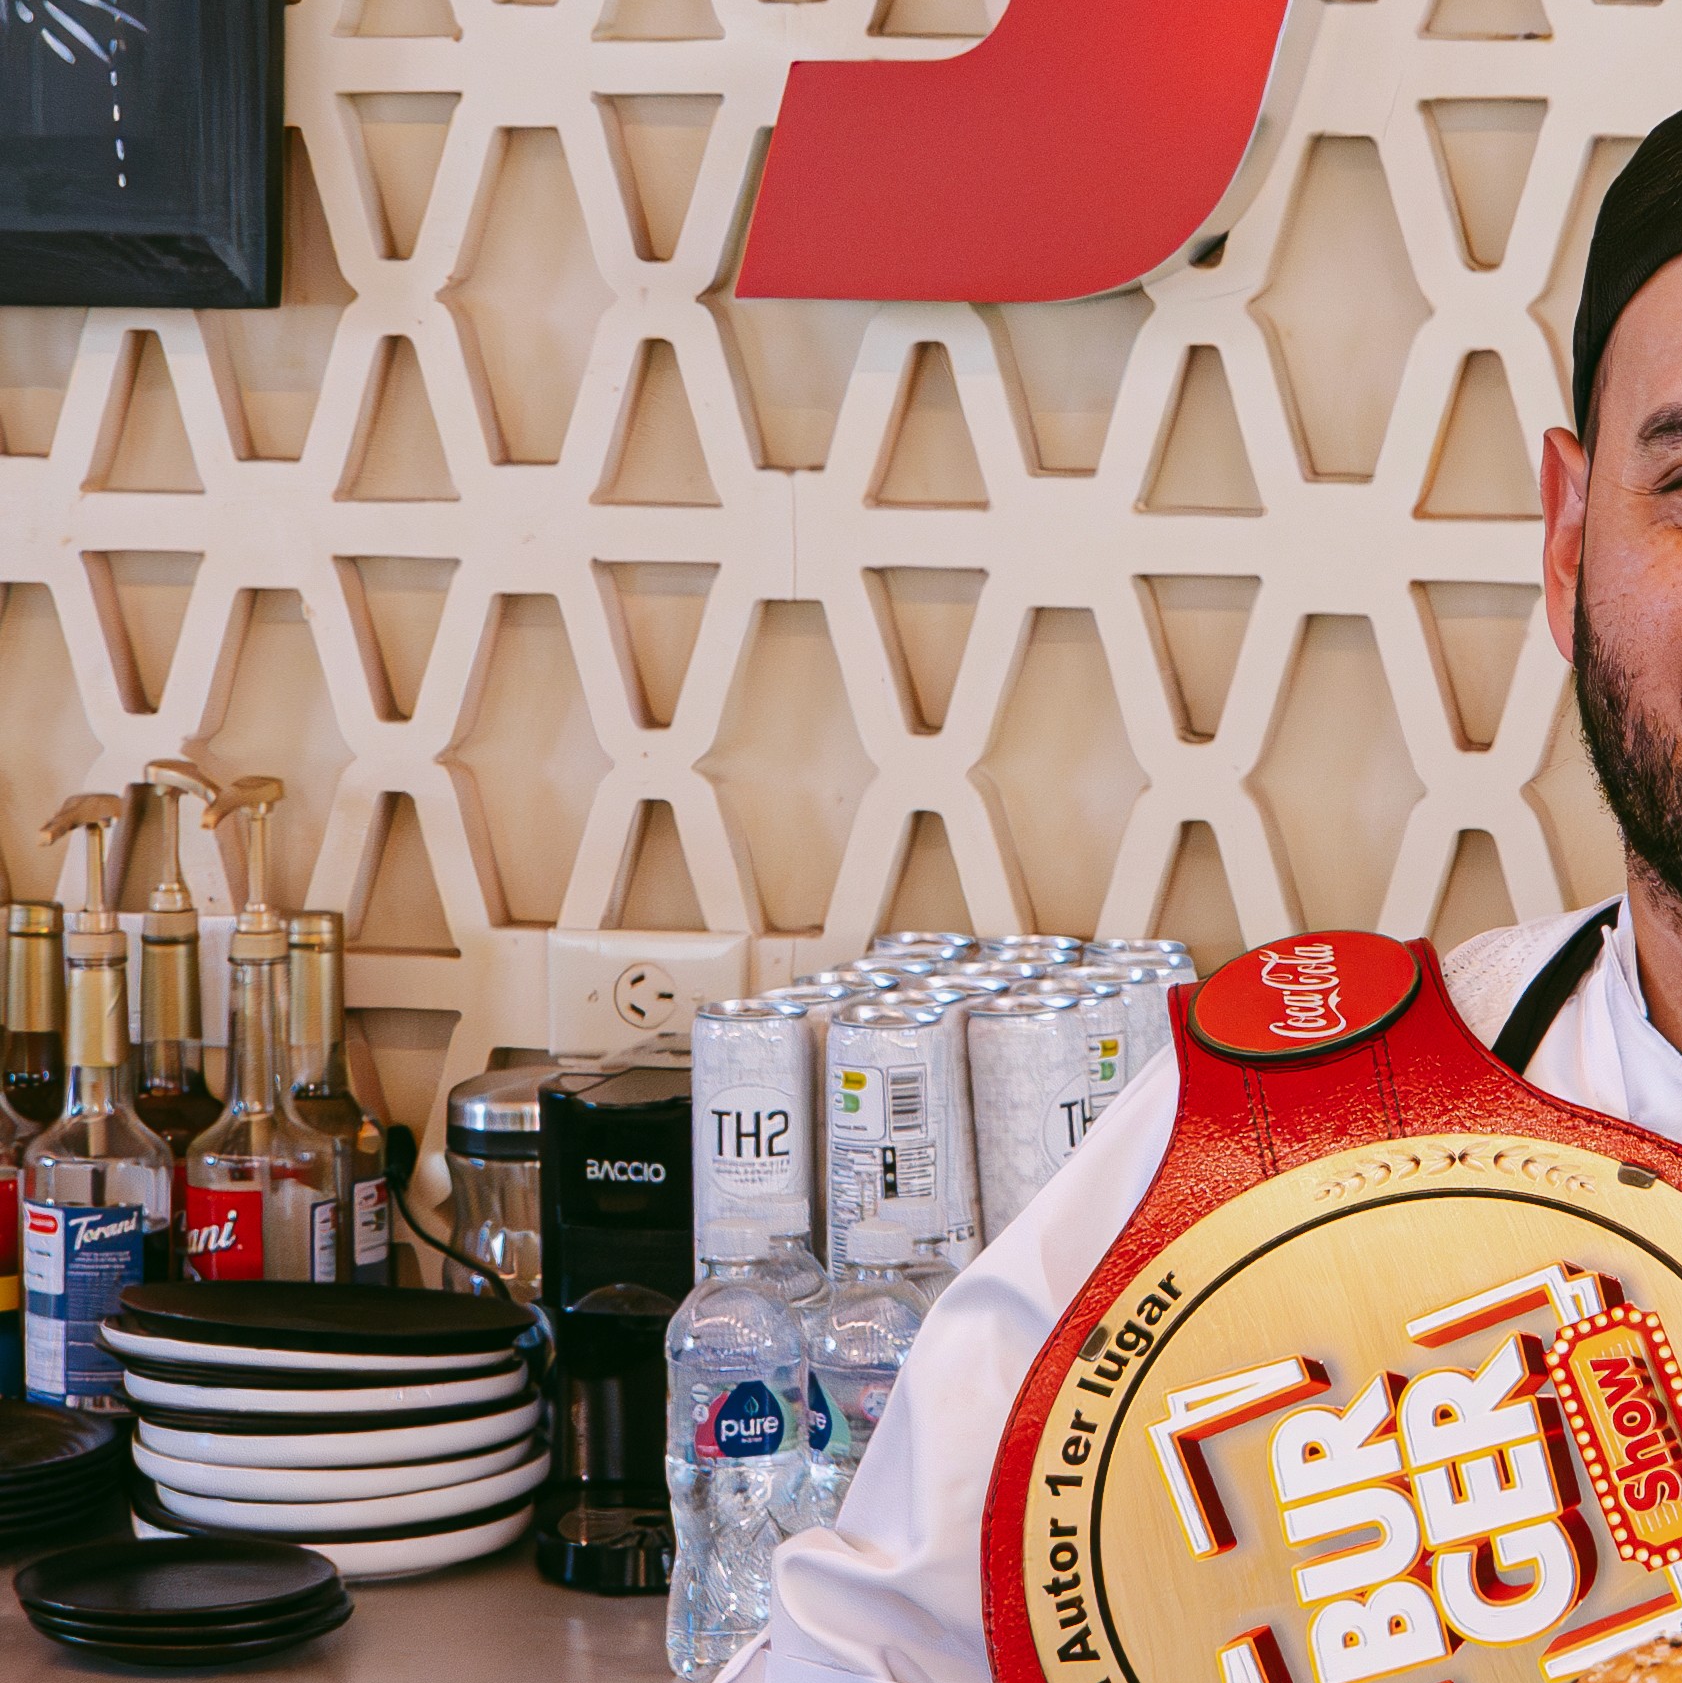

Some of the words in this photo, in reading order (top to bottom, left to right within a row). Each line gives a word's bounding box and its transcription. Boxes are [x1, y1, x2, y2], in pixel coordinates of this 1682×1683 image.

[1258, 942, 1347, 1039] Coca-Cola
[586, 1159, 667, 1184] BACCIO
[710, 1109, 790, 1159] TH2
[69, 1210, 138, 1252] Torani
[1076, 1270, 1187, 1398] lugar
[720, 1416, 780, 1442] pure
[1045, 1408, 1098, 1498] 1er
[1397, 1330, 1582, 1648] GER
[1042, 1518, 1101, 1664] Autor
